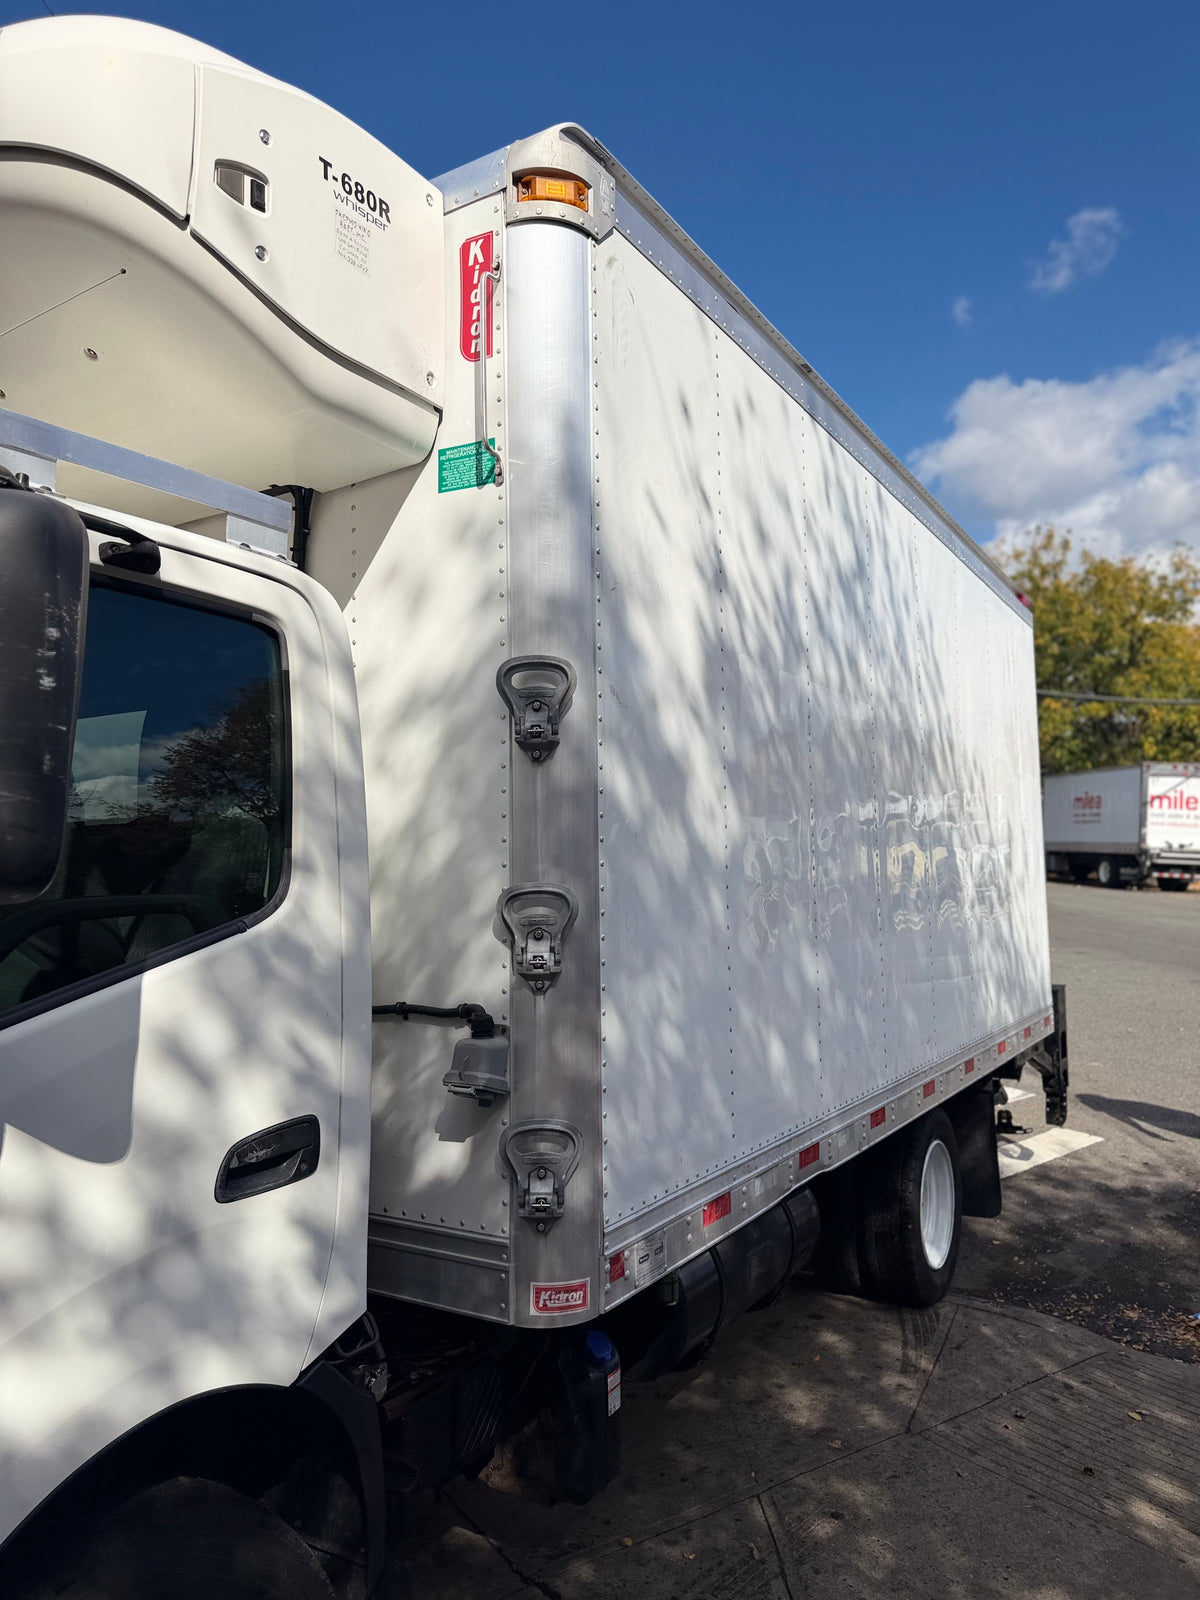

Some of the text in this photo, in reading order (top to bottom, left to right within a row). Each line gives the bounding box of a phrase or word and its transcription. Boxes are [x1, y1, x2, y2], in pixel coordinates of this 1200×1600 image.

[318, 155, 391, 224] T-680R
[333, 189, 388, 232] whisper
[539, 1291, 584, 1308] Kidron
